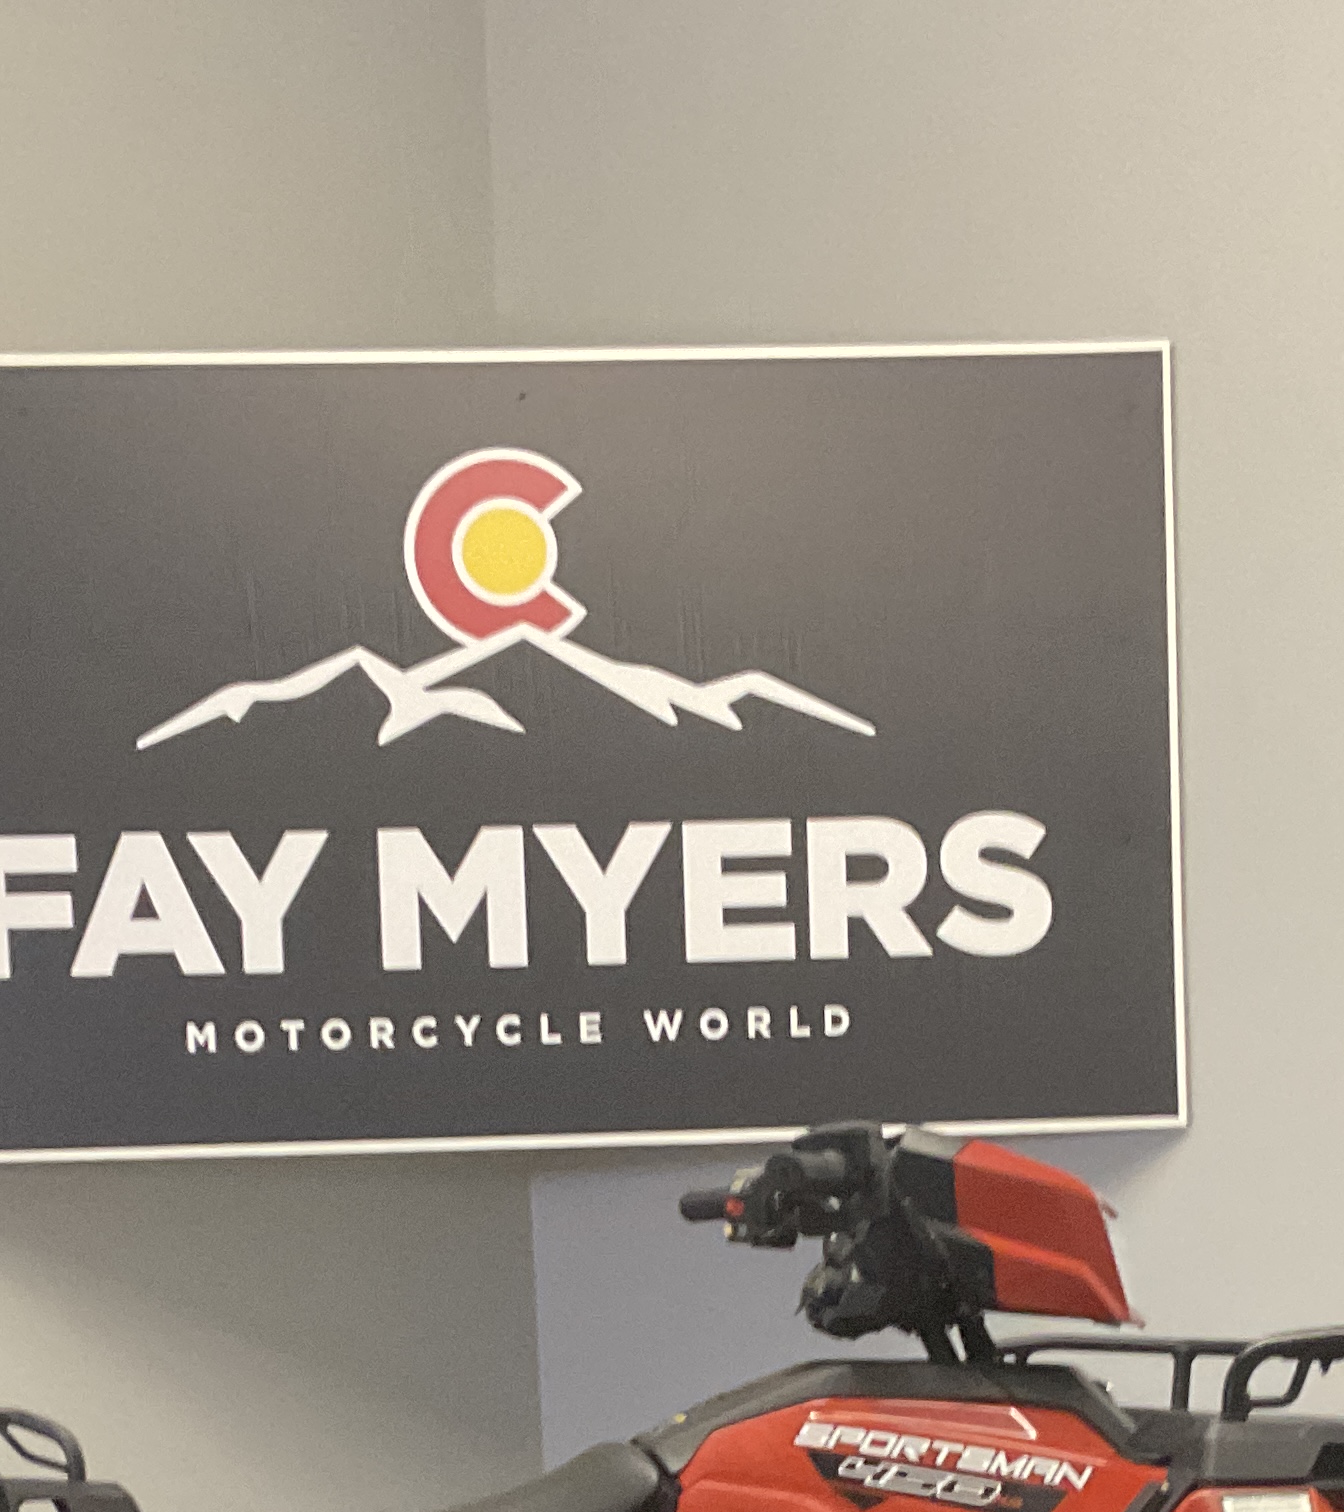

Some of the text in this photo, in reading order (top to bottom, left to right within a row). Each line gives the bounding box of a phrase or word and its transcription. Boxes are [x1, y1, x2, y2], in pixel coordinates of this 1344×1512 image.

[376, 810, 1053, 971] MYERS
[186, 1003, 853, 1053] MOTORCYCLE WORLD
[794, 1421, 1095, 1491] SPORTSMAN
